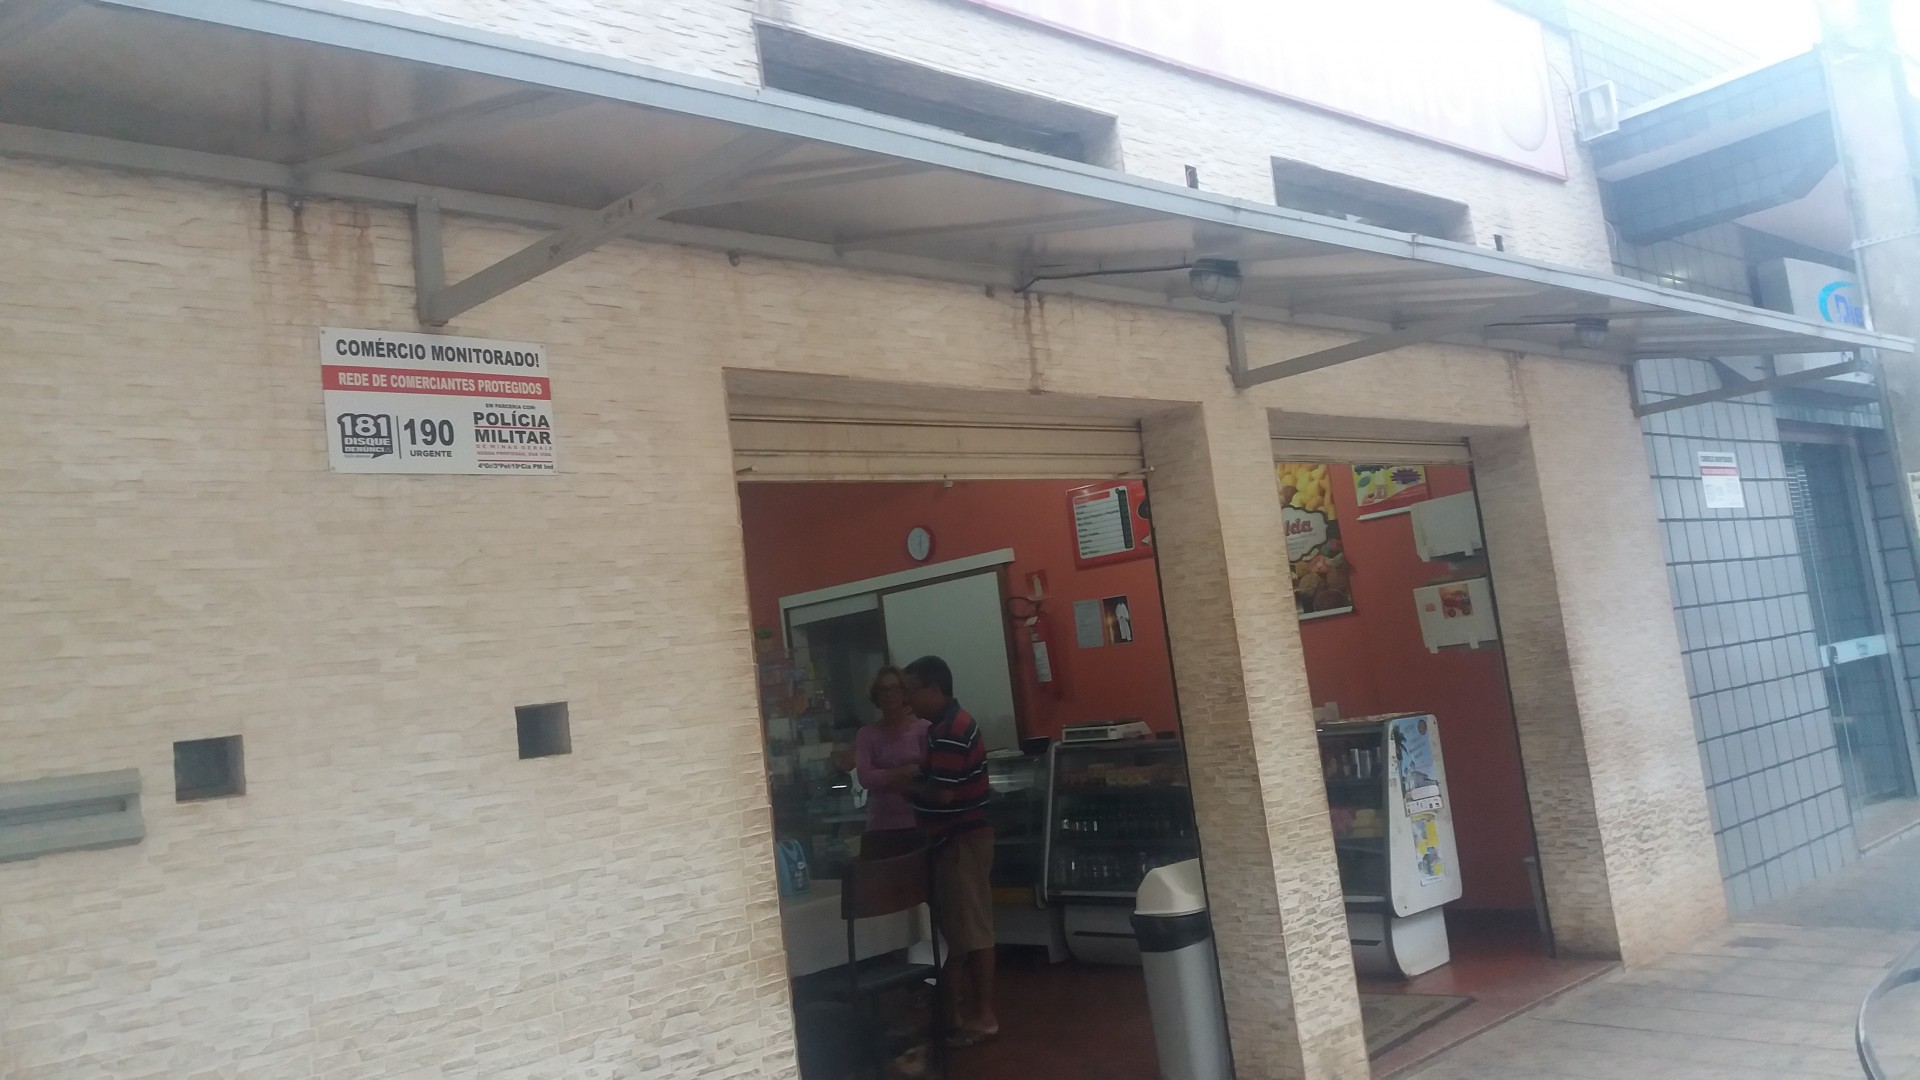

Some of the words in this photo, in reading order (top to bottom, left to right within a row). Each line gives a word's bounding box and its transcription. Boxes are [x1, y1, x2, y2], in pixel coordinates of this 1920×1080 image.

[336, 338, 426, 360] COMÉRCIO
[431, 345, 540, 368] MONITORADO!
[338, 372, 370, 387] REDE
[372, 373, 388, 388] DE
[390, 374, 476, 392] COMERCIANTES
[478, 379, 543, 395] PROTEGIDOS
[341, 414, 389, 437] 181
[473, 411, 550, 428] POLÍCIA
[403, 418, 455, 446] 190
[475, 429, 552, 445] MILITAR
[344, 437, 391, 447] DISQUE
[344, 445, 392, 453] DENÚNCIA
[410, 449, 453, 458] URGENTE
